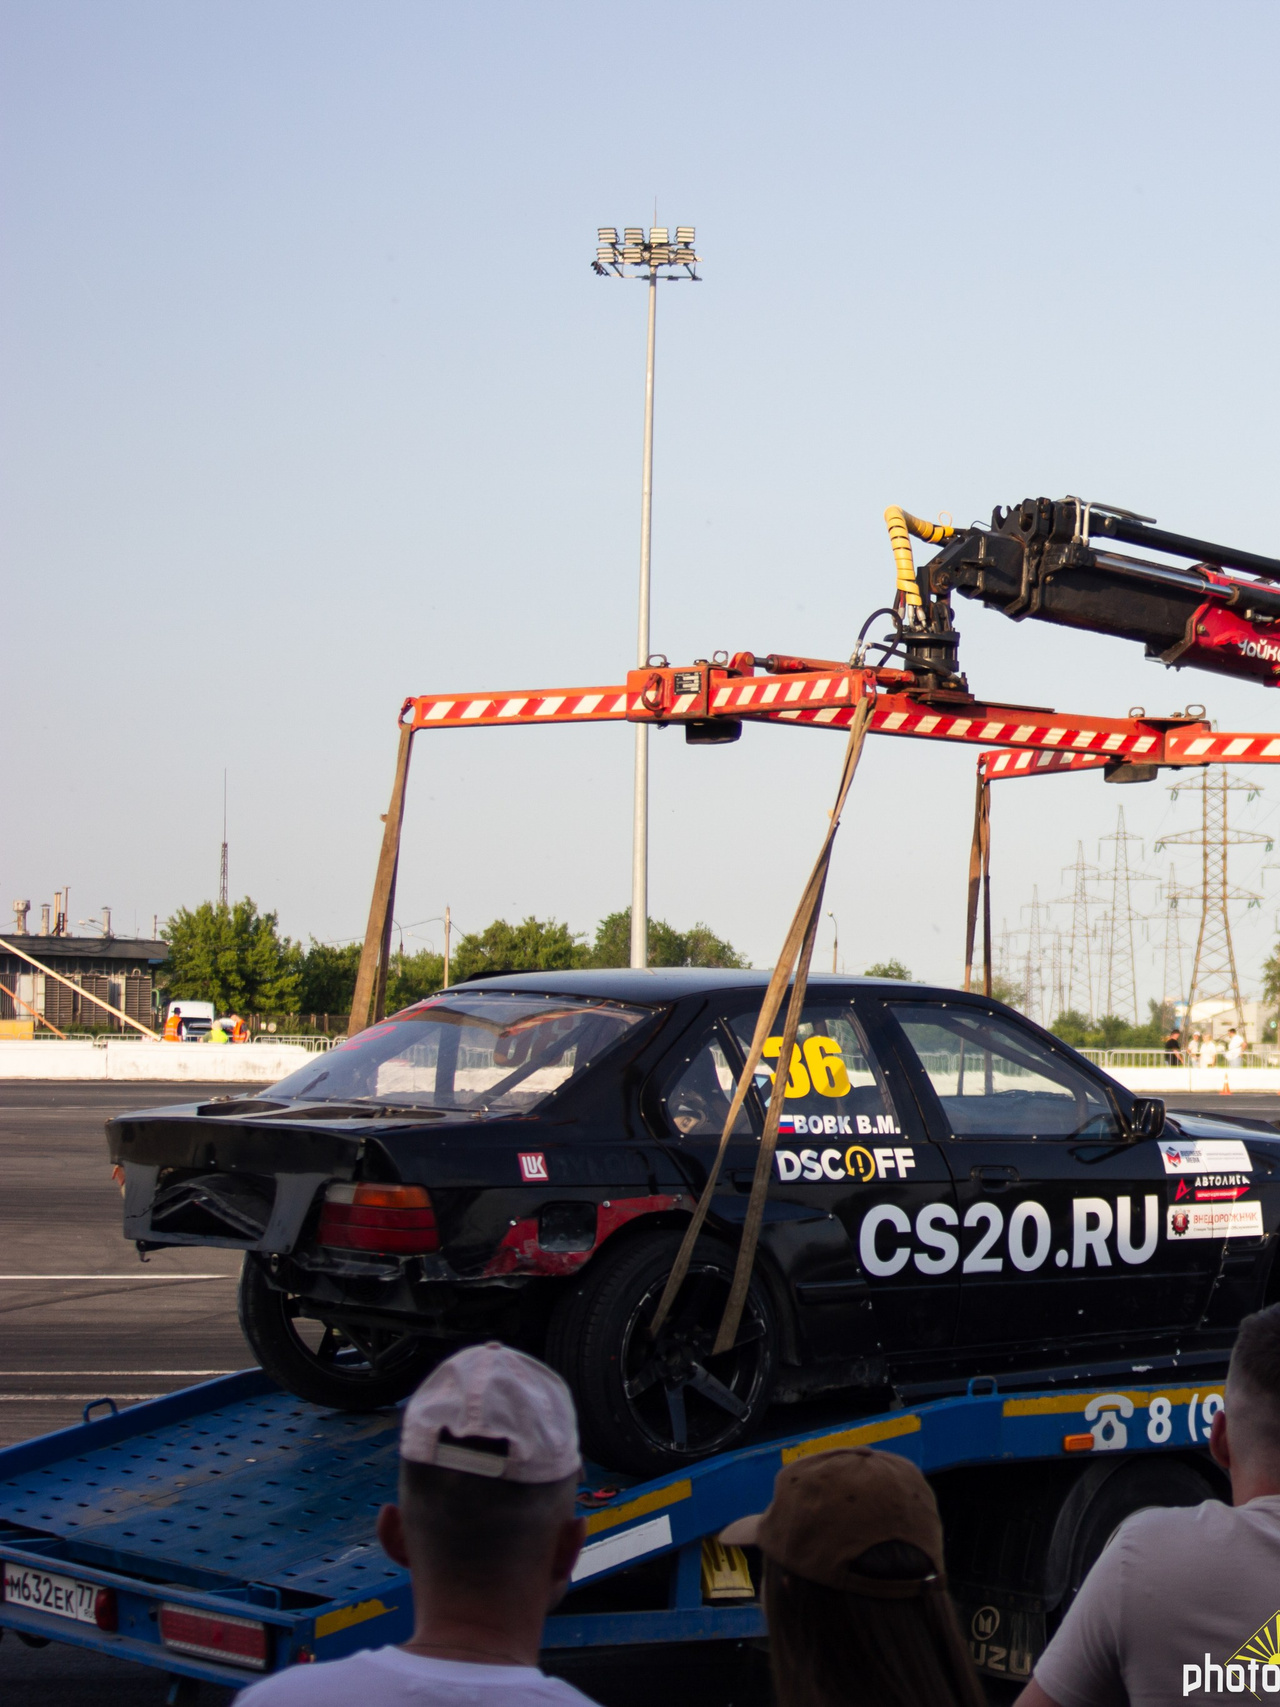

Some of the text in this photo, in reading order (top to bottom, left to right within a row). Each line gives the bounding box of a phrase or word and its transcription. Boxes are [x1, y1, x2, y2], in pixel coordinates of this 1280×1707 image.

[762, 1035, 852, 1099] 36
[794, 1114, 902, 1135] ВОВК В.М.
[1194, 1174, 1251, 1187] АВТОЛИГА
[1192, 1211, 1258, 1225] ВНЕДОРОЖНИК
[859, 1194, 1159, 1277] CS20.RU
[1147, 1396, 1173, 1444] 8
[77, 1583, 99, 1609] 77
